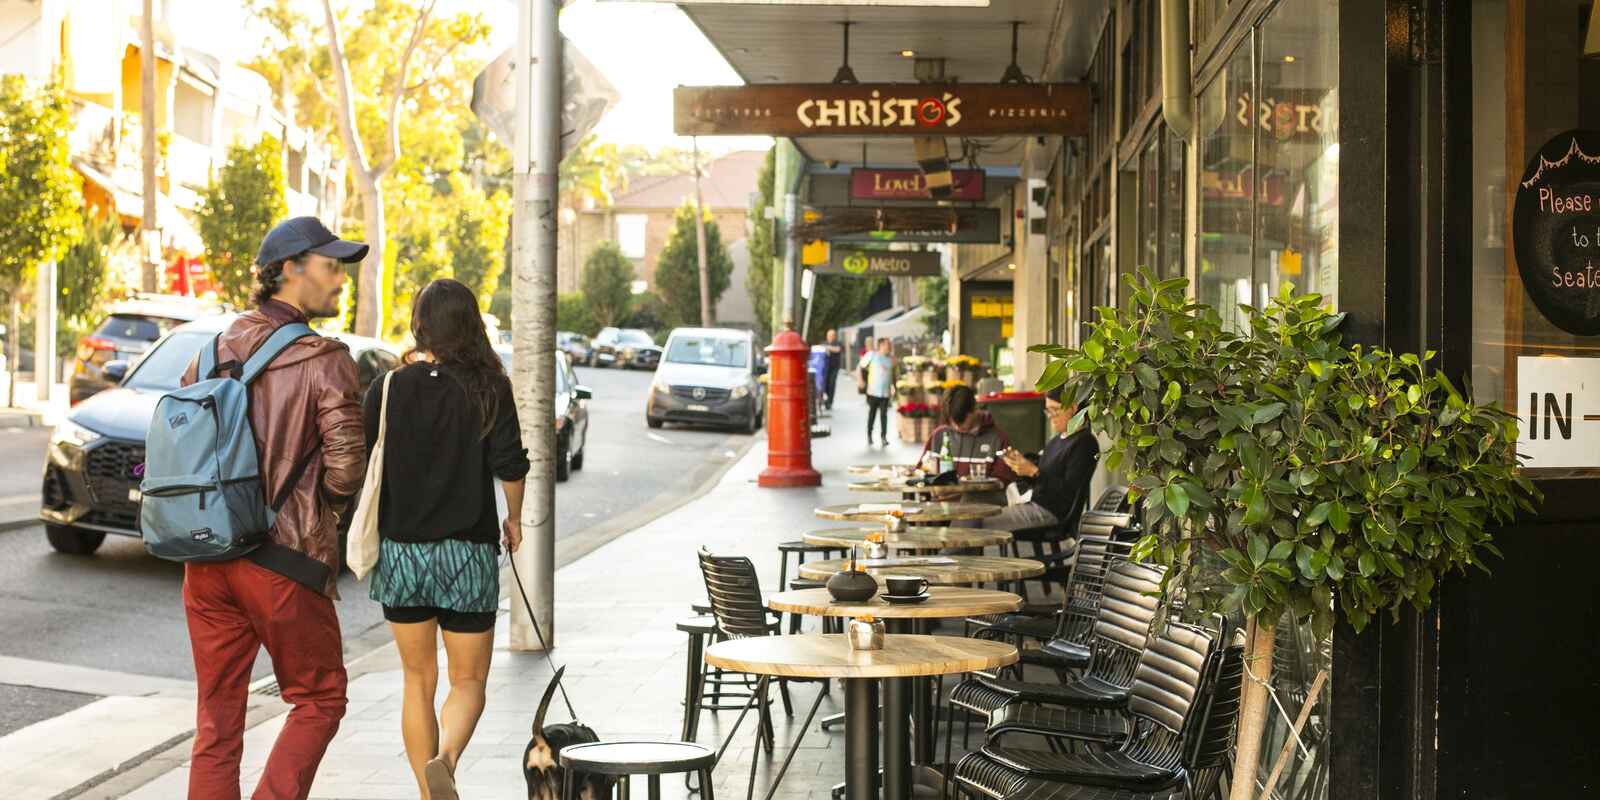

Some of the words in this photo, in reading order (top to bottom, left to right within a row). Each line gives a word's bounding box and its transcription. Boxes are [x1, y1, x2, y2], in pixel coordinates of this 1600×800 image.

[988, 107, 1068, 118] PIZZERIA
[1538, 186, 1592, 213] Please
[1571, 225, 1590, 247] to
[869, 256, 911, 272] Metro
[1529, 392, 1573, 440] IN
